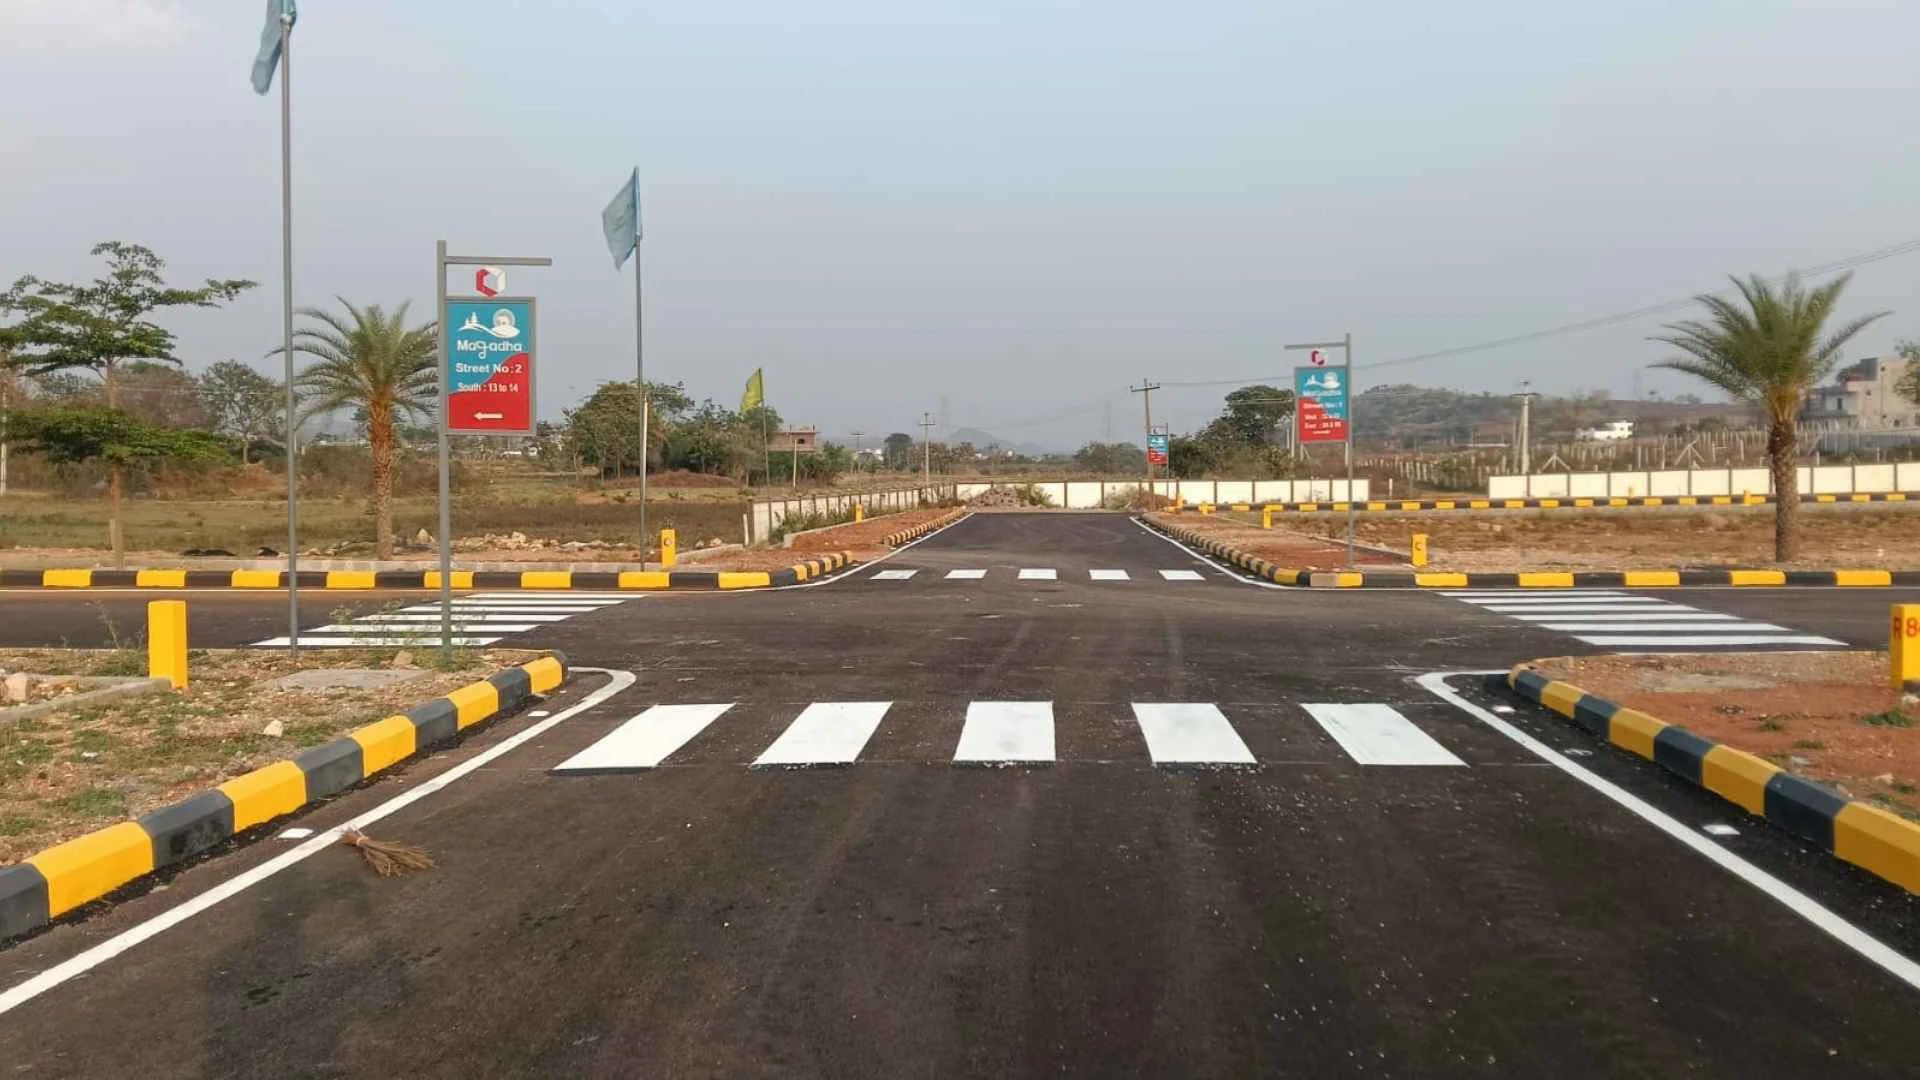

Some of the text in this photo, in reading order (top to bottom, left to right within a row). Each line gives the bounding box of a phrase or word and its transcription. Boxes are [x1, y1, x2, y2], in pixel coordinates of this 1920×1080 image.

[456, 339, 522, 360] Magadha
[455, 362, 490, 373] Street
[457, 382, 482, 392] South
[488, 383, 498, 392] 13
[499, 383, 508, 392] to
[509, 383, 519, 392] 14
[1906, 617, 1920, 638] 8
